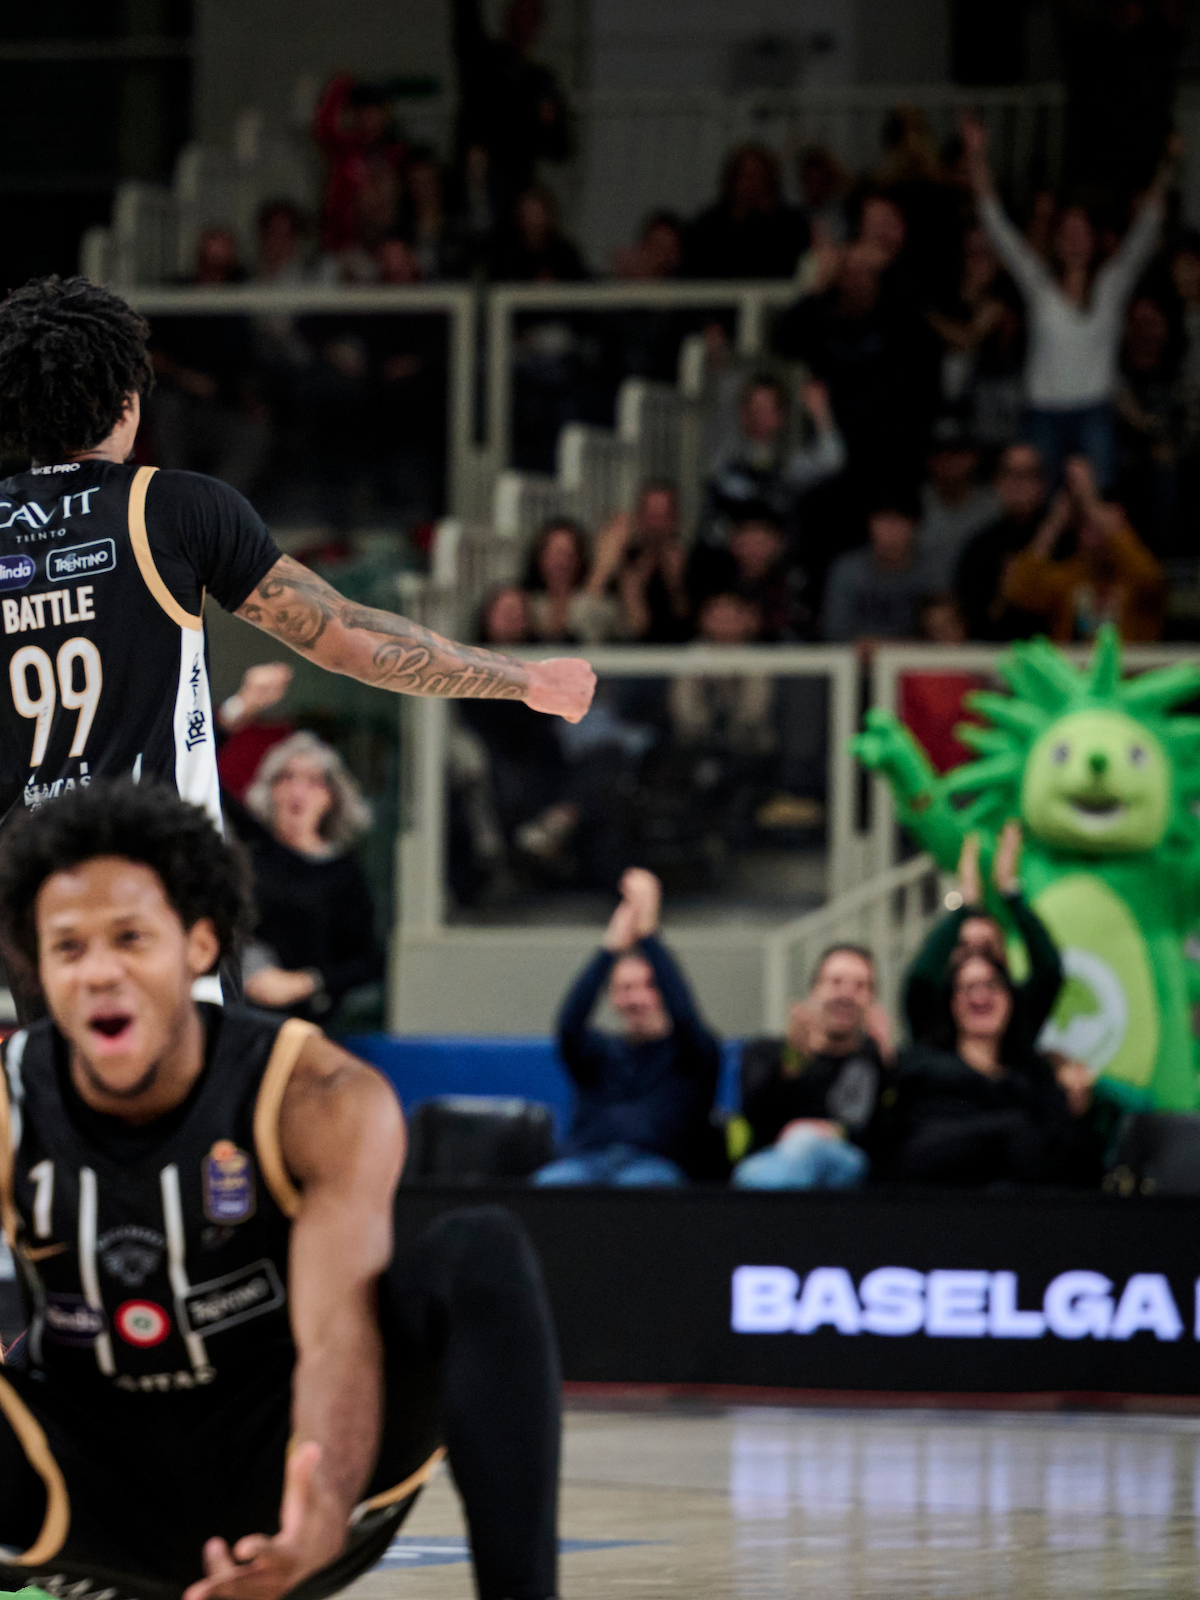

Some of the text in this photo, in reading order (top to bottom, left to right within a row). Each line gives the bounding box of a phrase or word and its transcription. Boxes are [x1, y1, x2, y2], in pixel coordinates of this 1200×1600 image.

[52, 462, 81, 474] PRO
[54, 549, 109, 573] TRENTINO
[1, 585, 96, 635] BATTLE
[9, 636, 103, 768] 99
[28, 1159, 55, 1239] 1
[730, 1264, 1185, 1342] BASELGA
